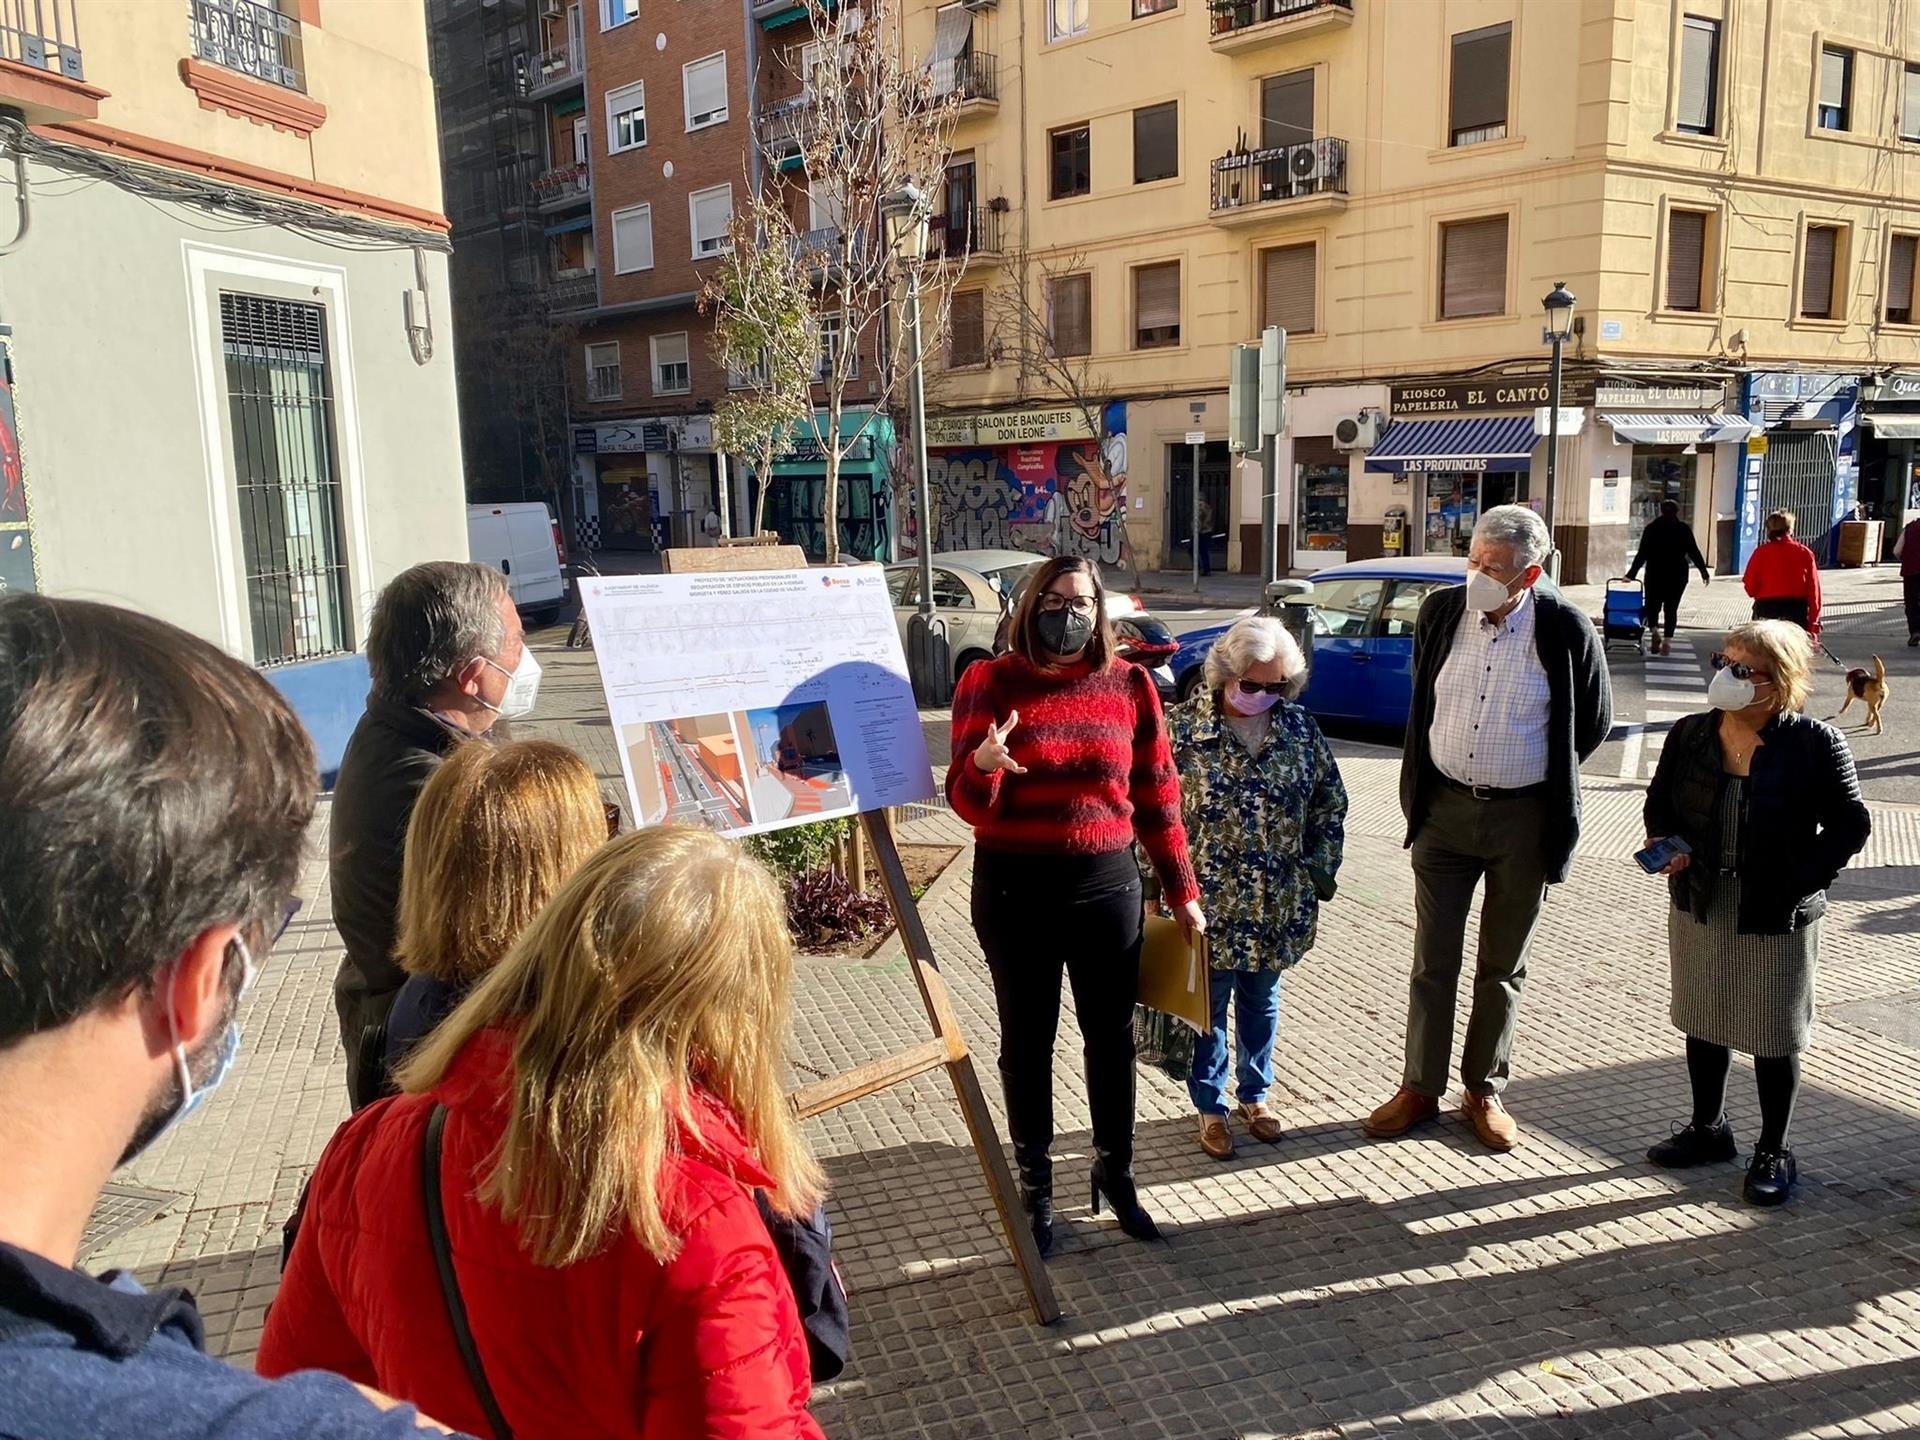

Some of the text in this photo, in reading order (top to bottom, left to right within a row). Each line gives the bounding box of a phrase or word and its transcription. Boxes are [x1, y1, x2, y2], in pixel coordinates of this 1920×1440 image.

[1604, 380, 1637, 391] KIOSCO
[1402, 388, 1446, 399] KIOSCO
[1467, 391, 1487, 404] EL
[1496, 383, 1550, 403] CANTÓ
[1598, 392, 1645, 404] PAPELERIA
[1648, 387, 1662, 400] EL
[1393, 400, 1459, 412] PAPELERIA
[977, 412, 1072, 429] SALON DE BANQUETES
[998, 427, 1045, 440] DON LEONE
[1403, 459, 1488, 472] LAS PROVINCIAS
